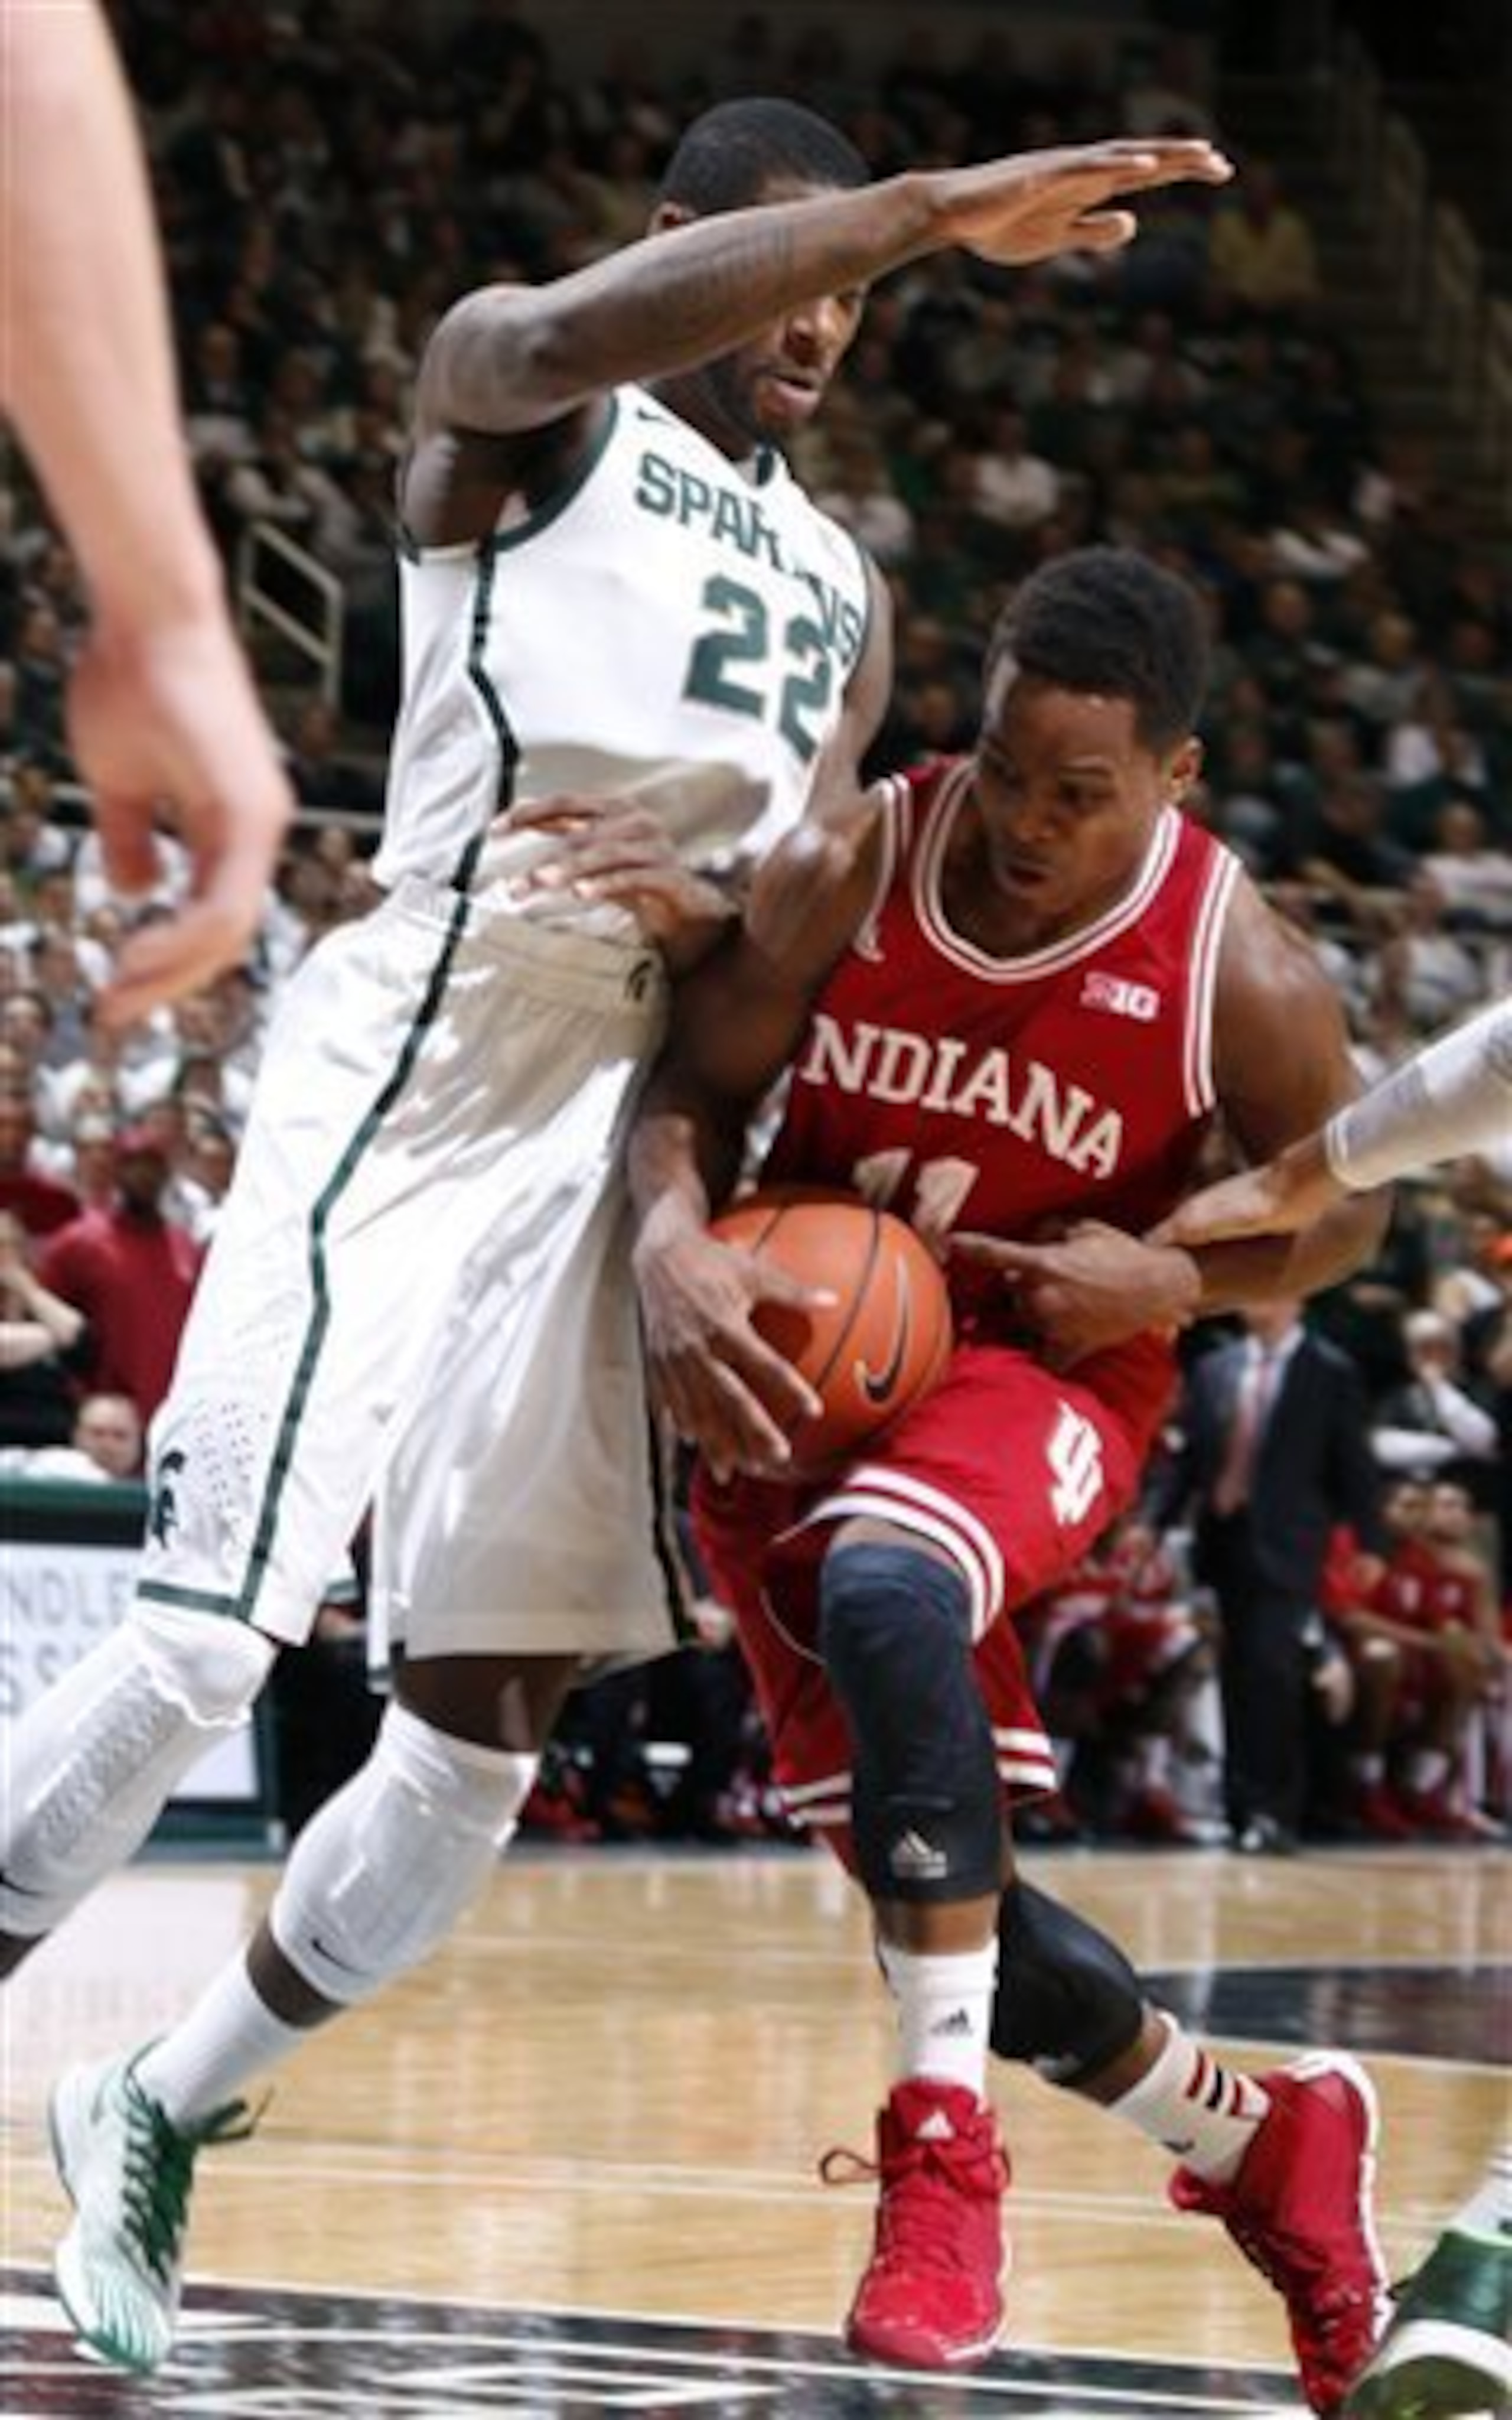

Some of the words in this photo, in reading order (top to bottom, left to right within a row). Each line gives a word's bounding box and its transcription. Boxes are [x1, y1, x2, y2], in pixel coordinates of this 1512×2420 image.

[635, 450, 863, 666] SPARNS
[681, 573, 830, 764] 22
[799, 1013, 1122, 1179] NDIANA
